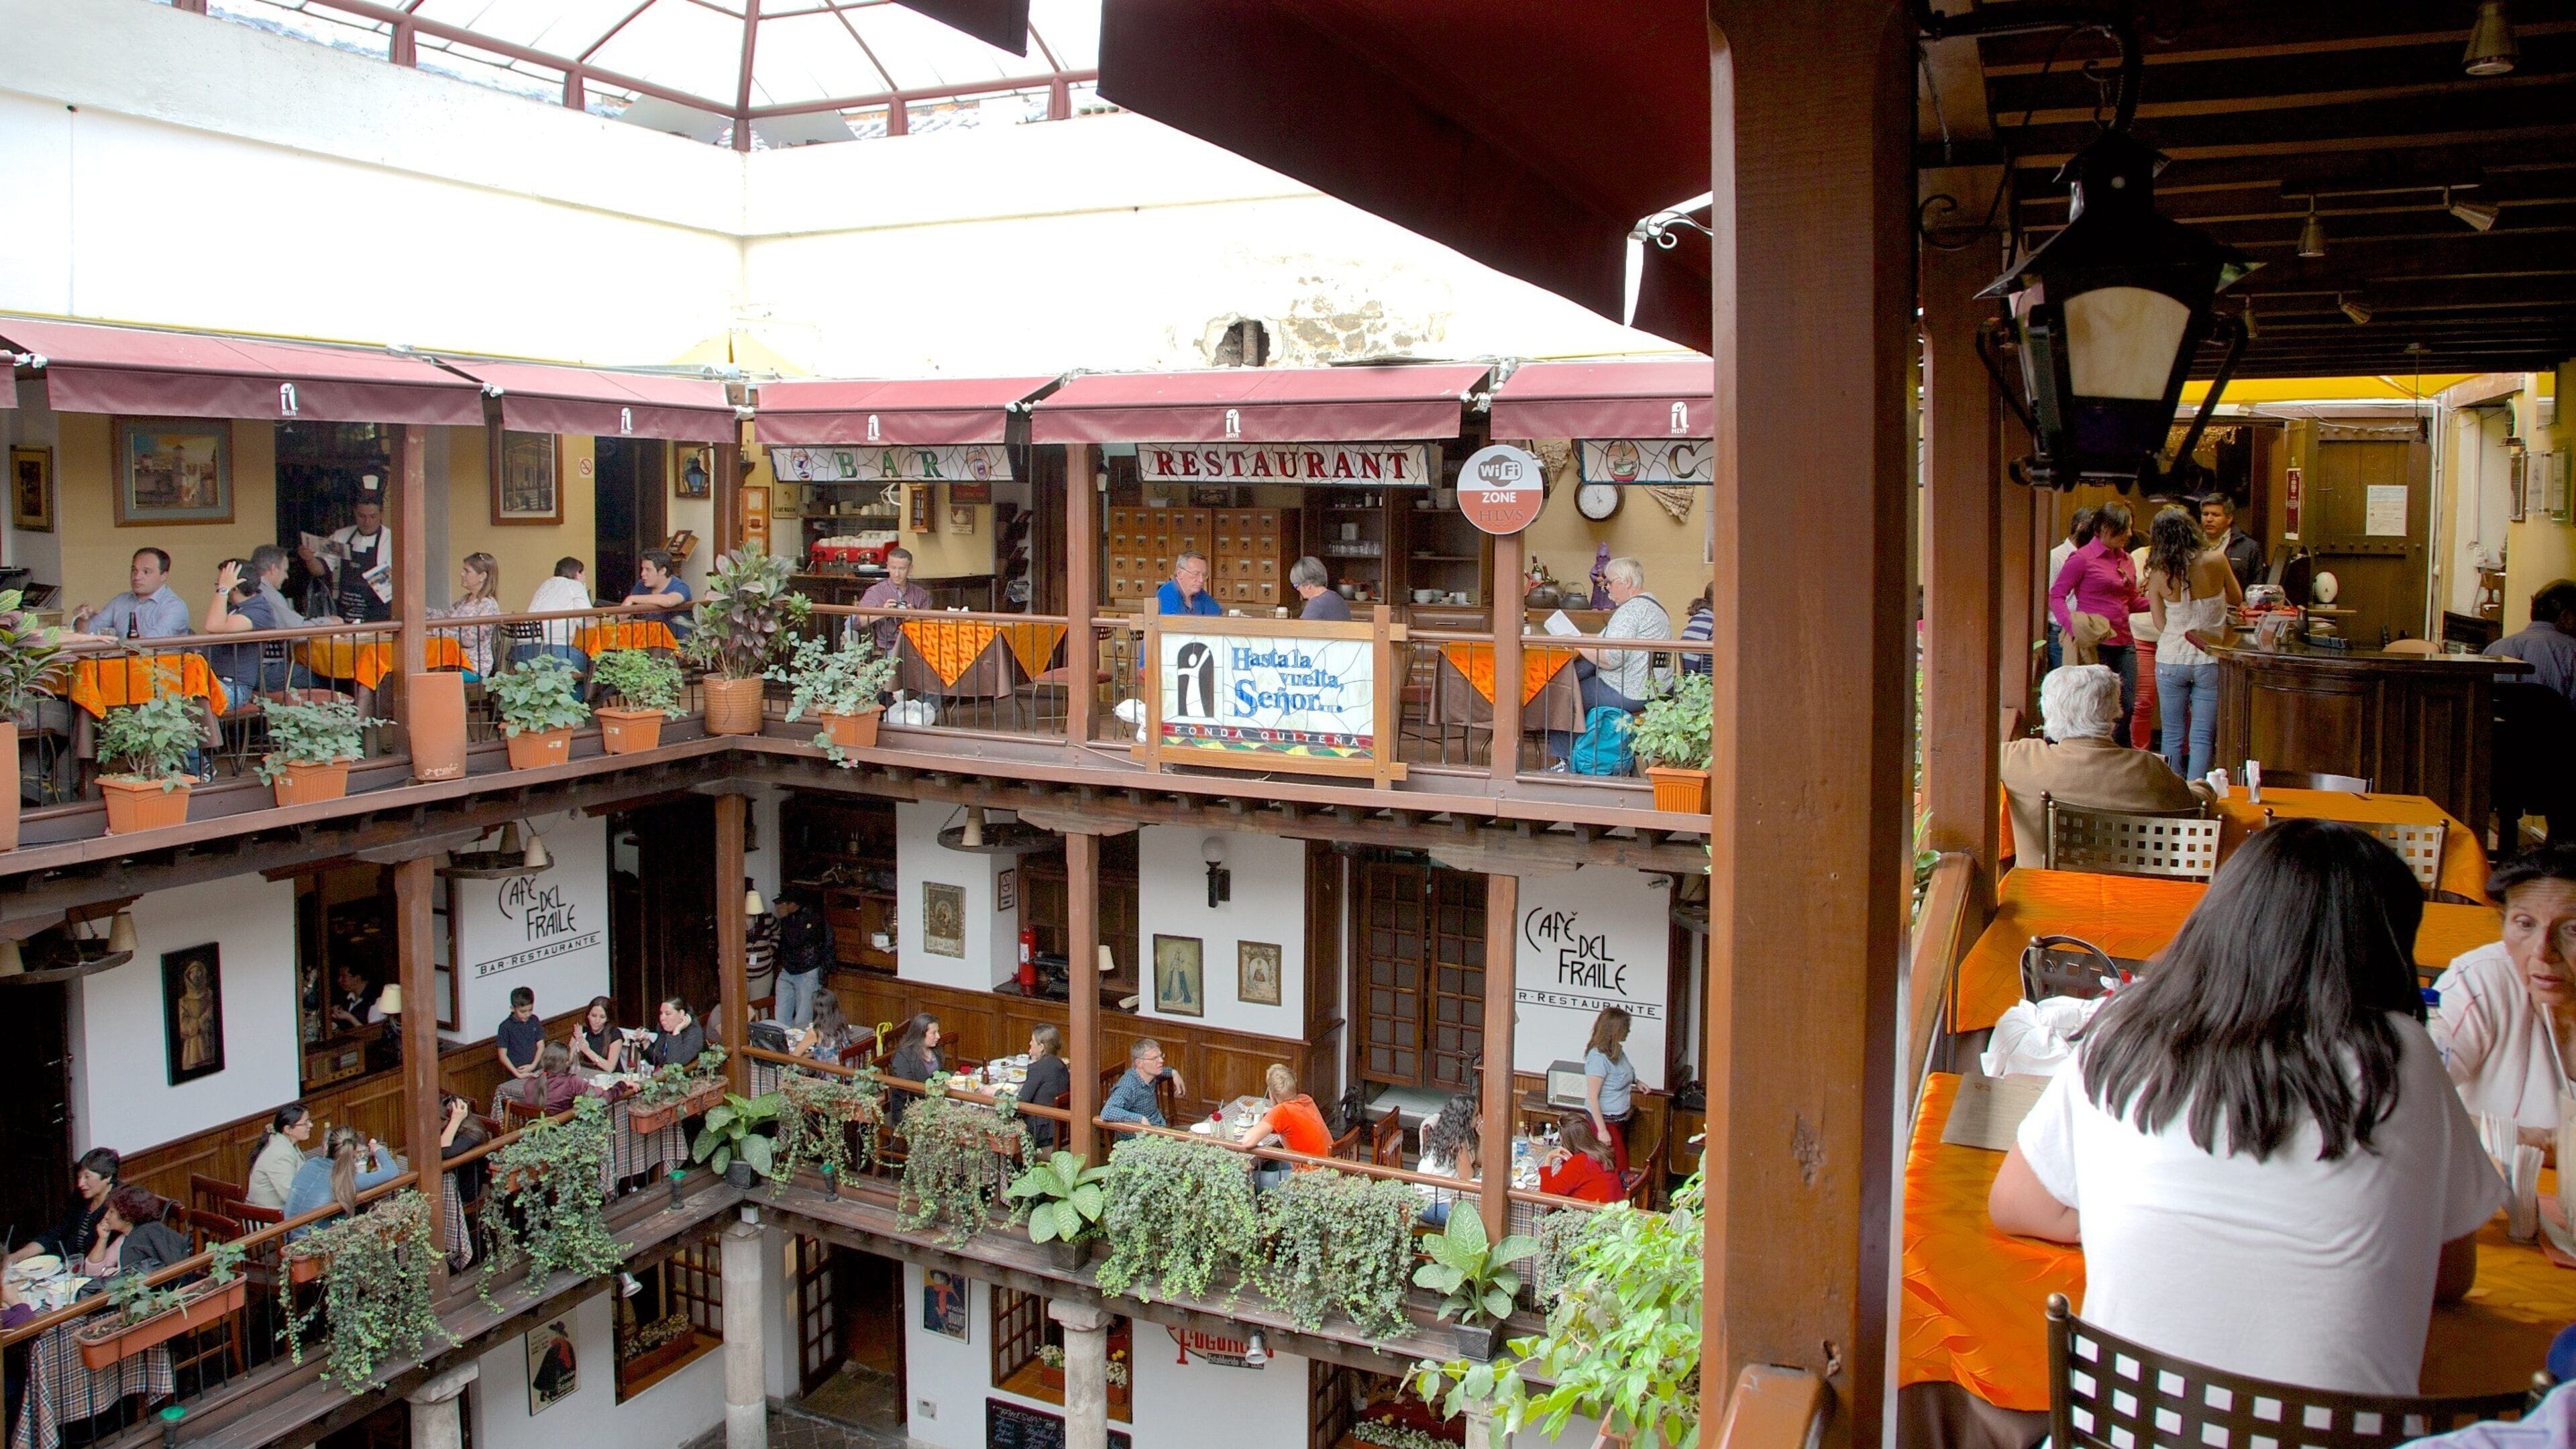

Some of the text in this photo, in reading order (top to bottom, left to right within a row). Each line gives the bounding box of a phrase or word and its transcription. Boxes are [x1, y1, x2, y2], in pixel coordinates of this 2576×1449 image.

[835, 451, 943, 478] BAR
[1157, 451, 1409, 479] RESTAURANT
[1482, 492, 1517, 503] ZONE
[1479, 508, 1524, 522] HLVS
[1232, 647, 1313, 671] Hasta la
[1175, 726, 1359, 747] FONDA QUITEÑA
[540, 885, 566, 912] DEL
[527, 904, 576, 941] FRAILE
[1579, 934, 1615, 961] DEL
[1559, 948, 1627, 996] FRAILE
[1208, 1354, 1238, 1366] Establecido
